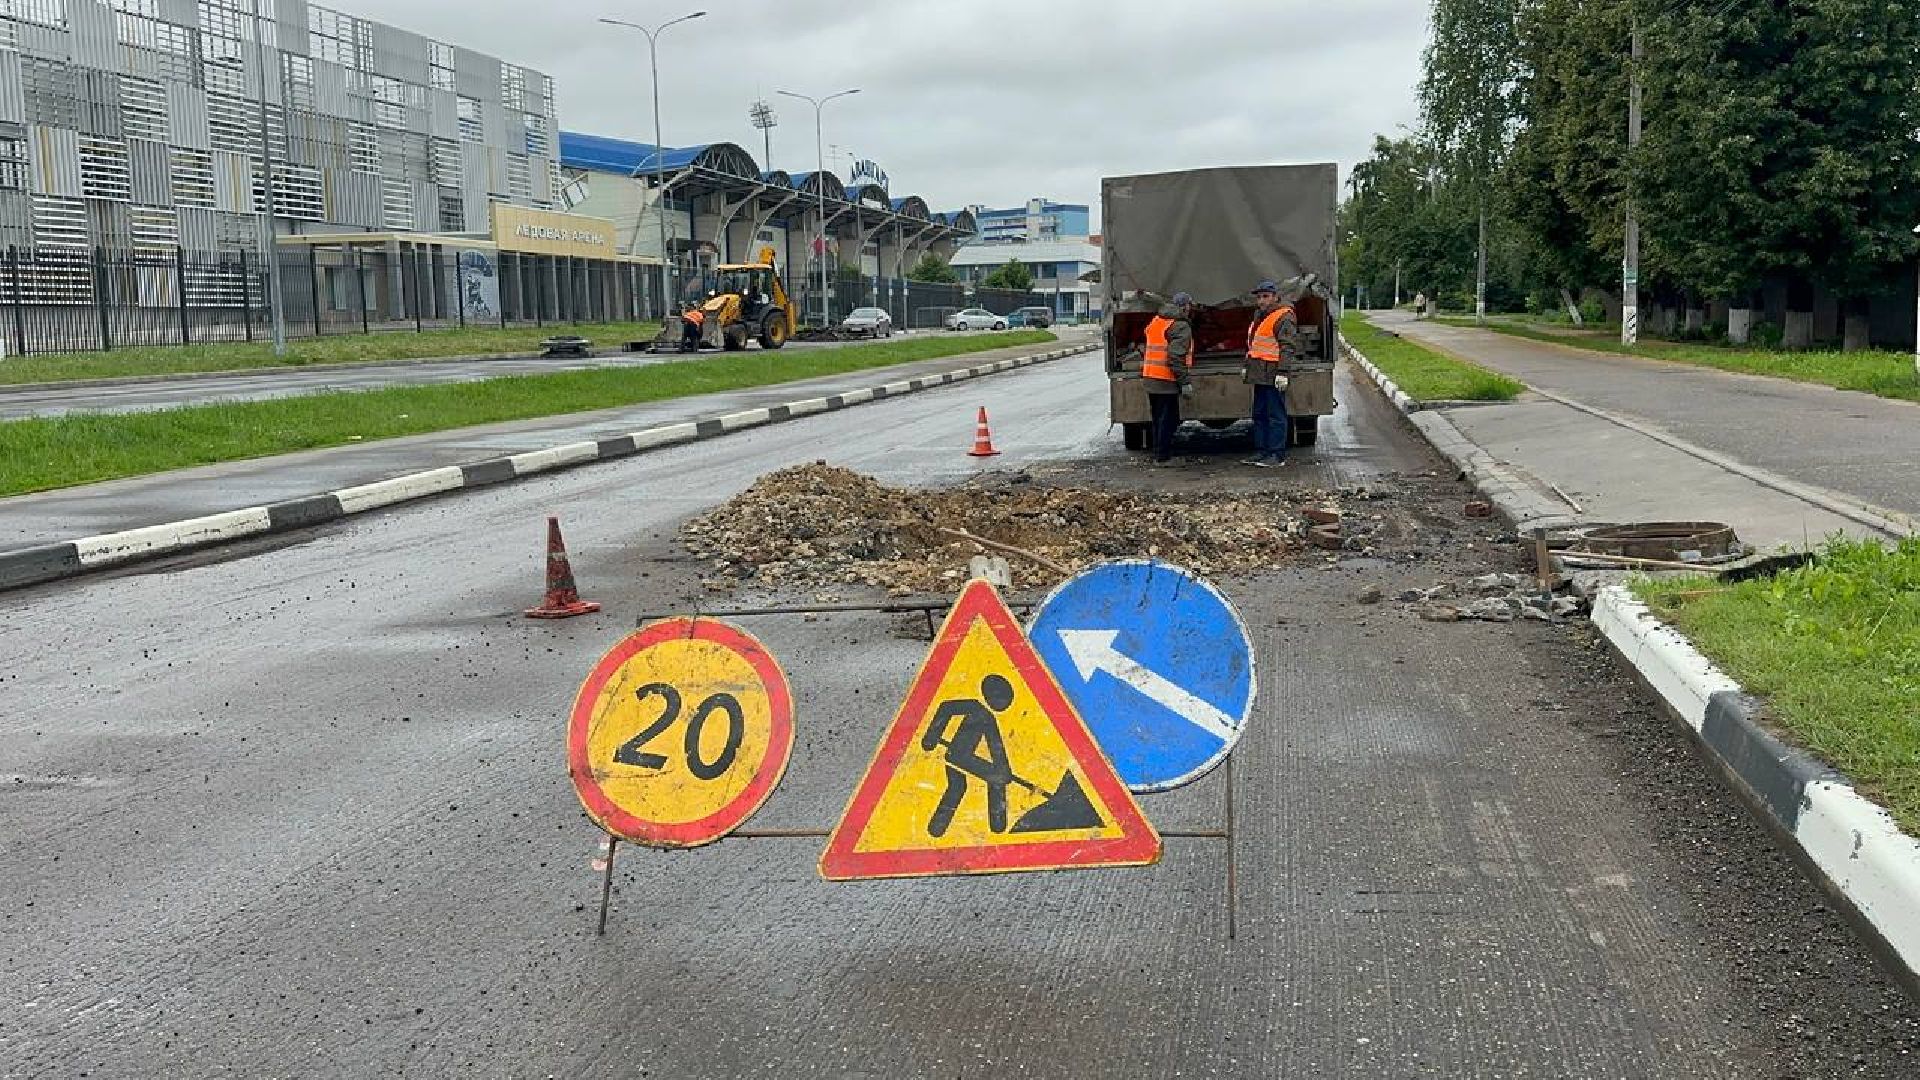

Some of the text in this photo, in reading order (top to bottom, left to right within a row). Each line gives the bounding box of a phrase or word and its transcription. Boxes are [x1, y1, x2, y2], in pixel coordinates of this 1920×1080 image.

[515, 224, 605, 246] ЛЕДОВАЯ АРЕНА
[613, 682, 745, 780] 20
